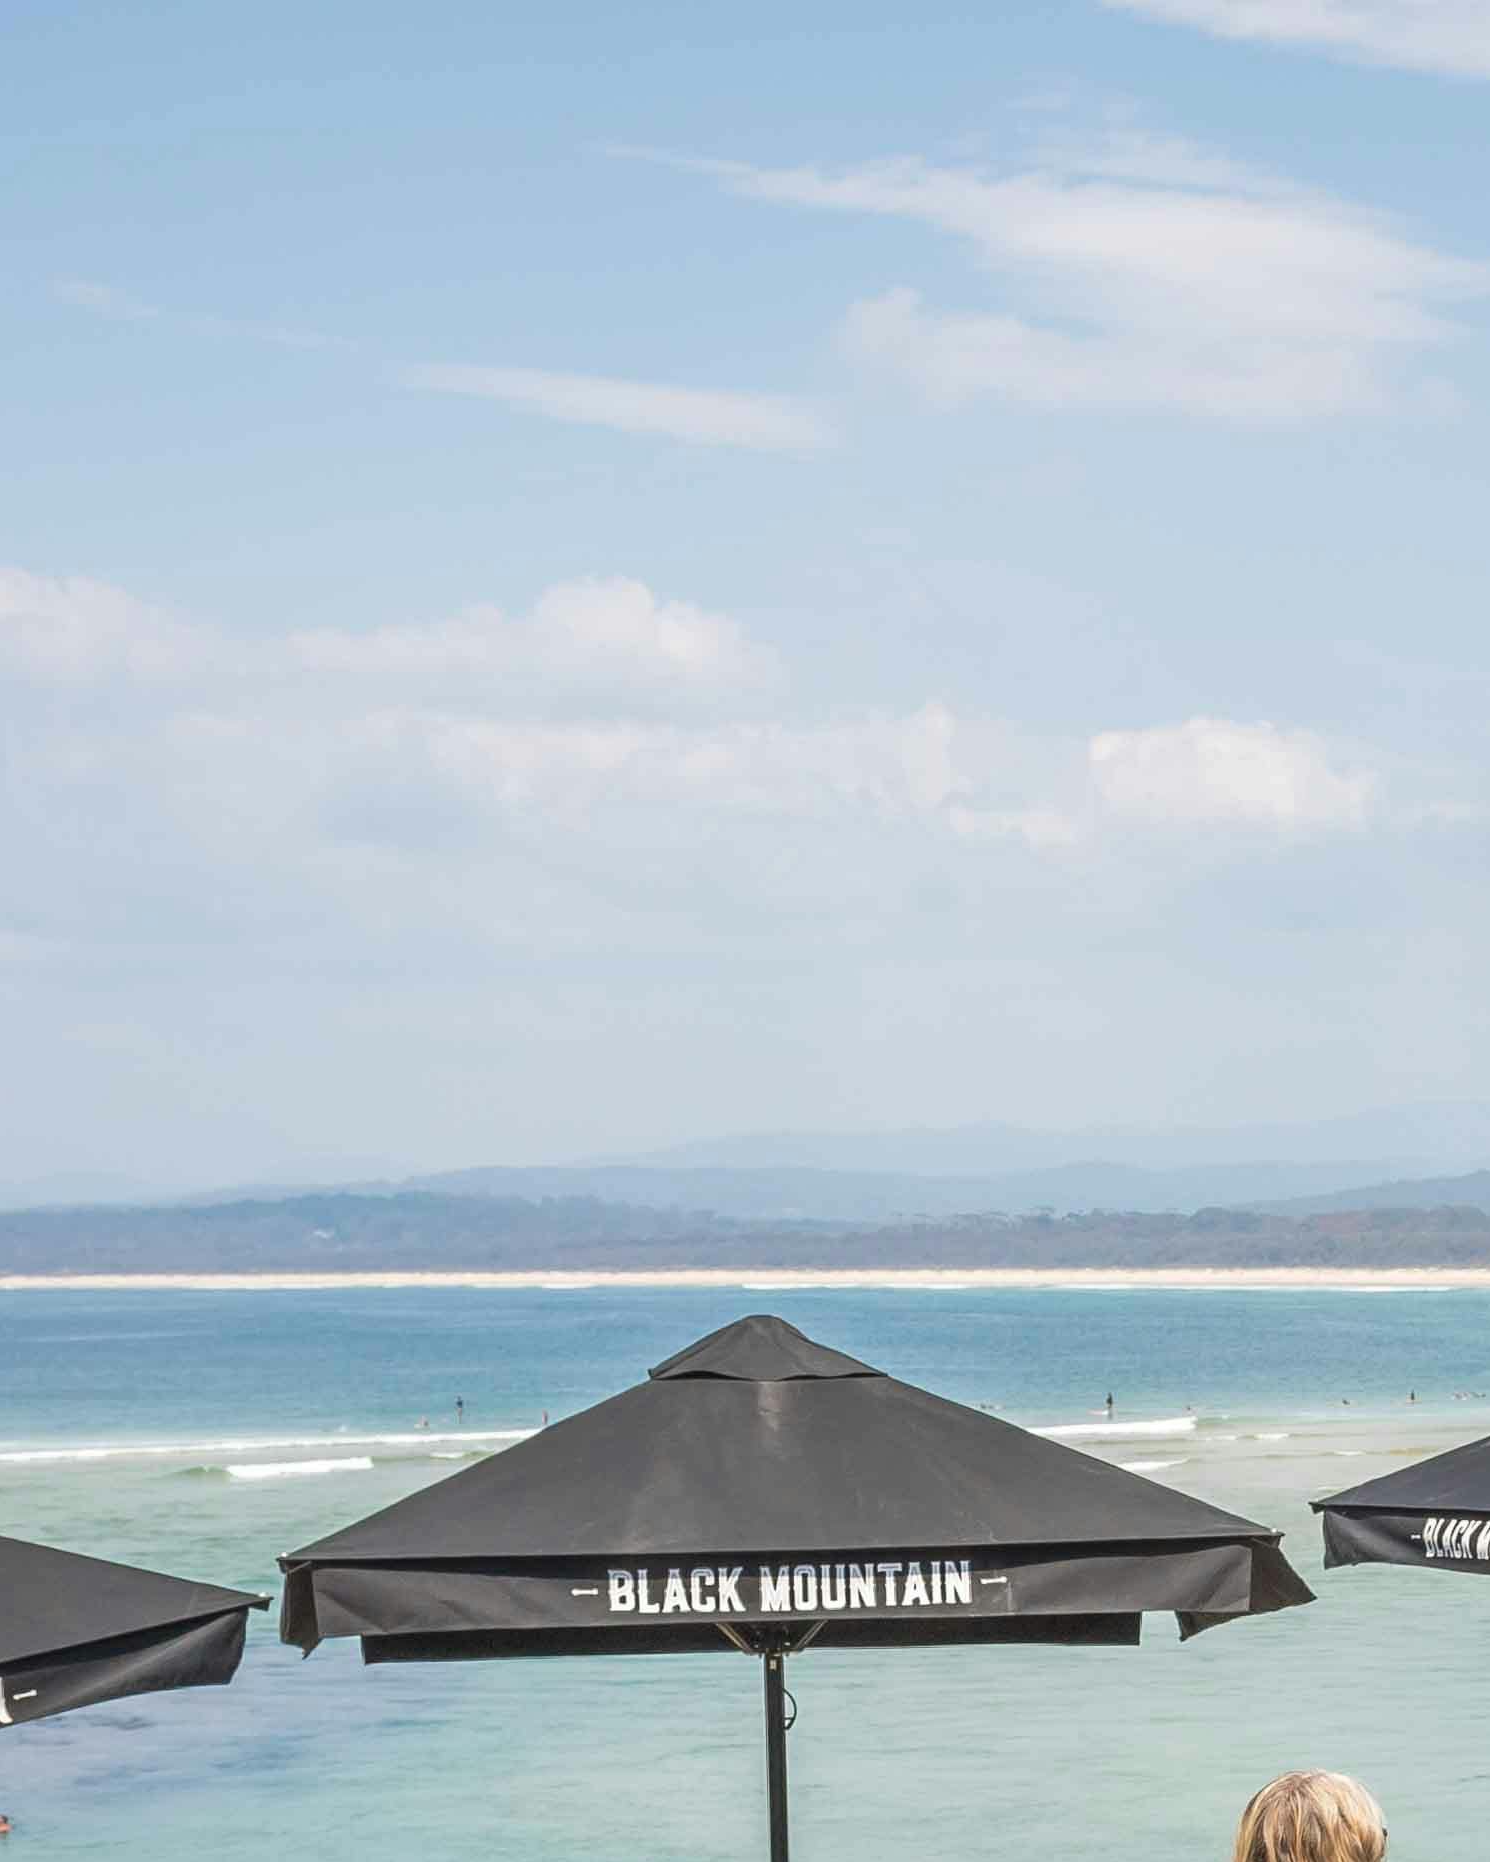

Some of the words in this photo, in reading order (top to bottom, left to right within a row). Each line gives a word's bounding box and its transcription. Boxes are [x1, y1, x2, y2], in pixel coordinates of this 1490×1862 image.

[1423, 1517, 1482, 1559] BLACK
[607, 1566, 746, 1614] BLACK
[759, 1560, 973, 1614] MOUNTAIN
